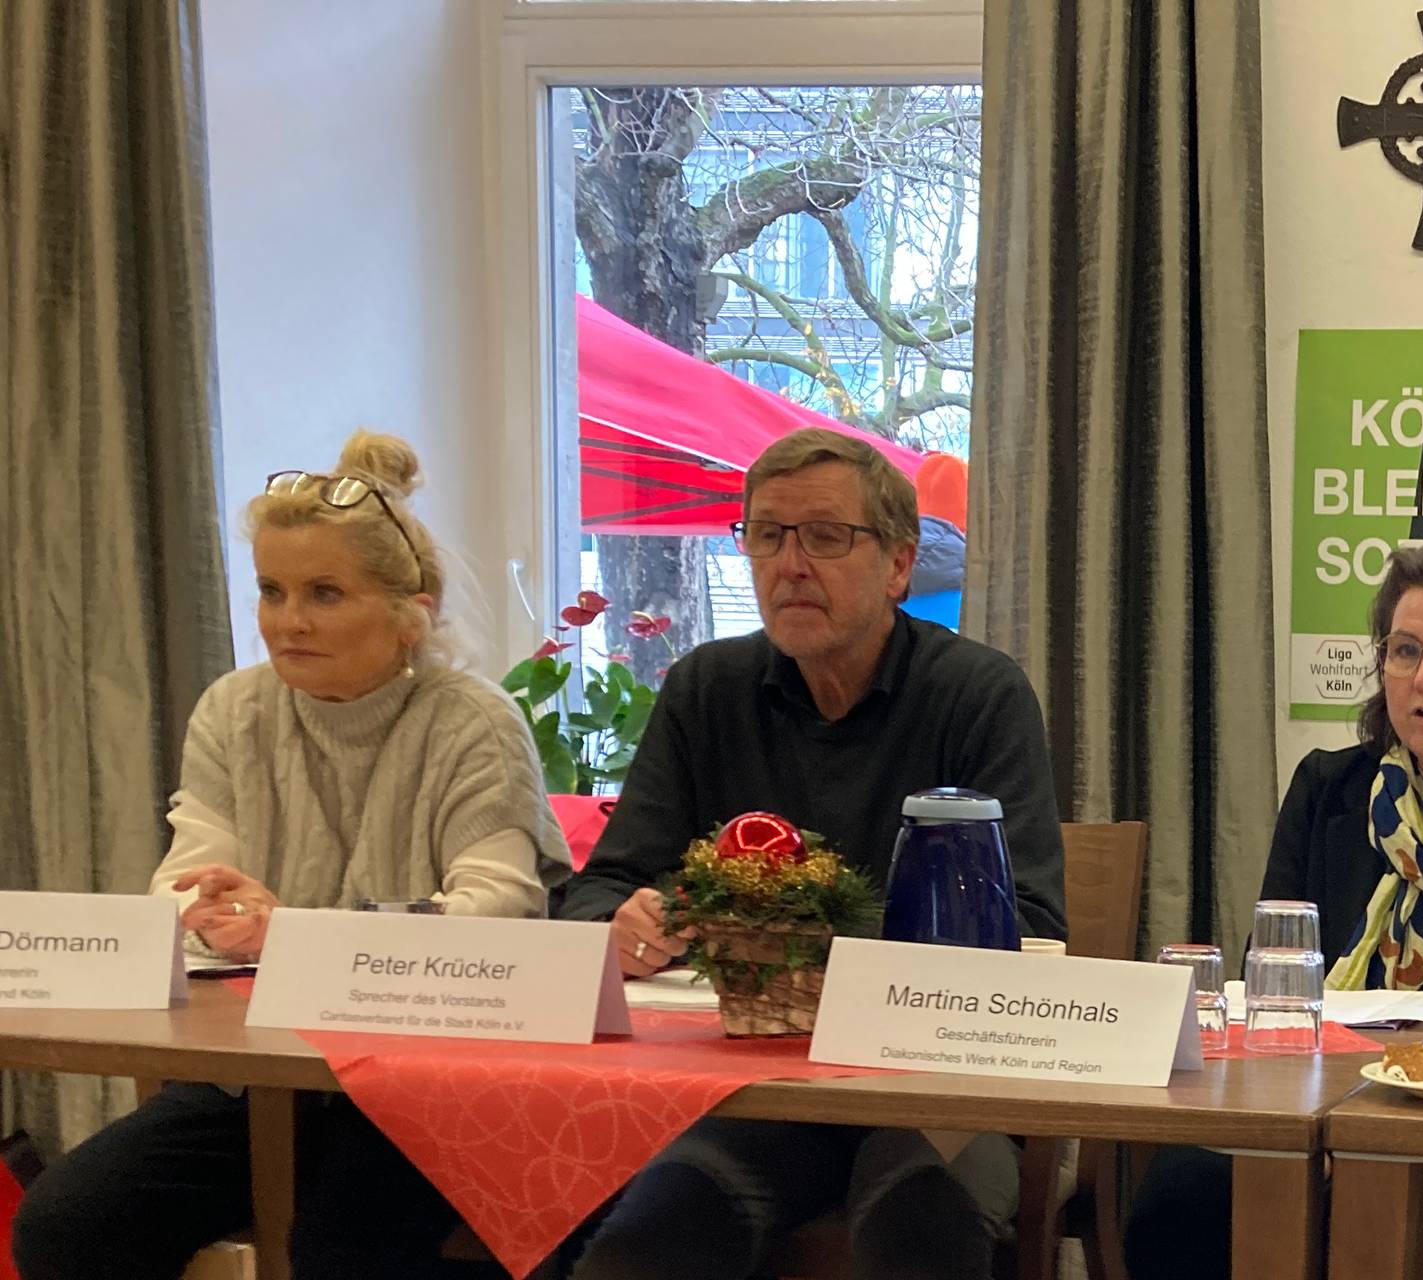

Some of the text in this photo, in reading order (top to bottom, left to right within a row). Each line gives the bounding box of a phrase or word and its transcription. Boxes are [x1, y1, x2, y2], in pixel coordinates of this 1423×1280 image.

[1328, 648, 1352, 661] Liga
[1310, 664, 1368, 675] Wohlfahrt
[1326, 679, 1352, 691] Köln
[352, 953, 515, 979] Peter Krücker
[348, 989, 506, 1008] Sprecher des Vorstands
[886, 984, 1119, 1023] Martina Schönhals
[936, 1026, 1057, 1048] Geschäftsführerin
[881, 1046, 1102, 1075] Diakonisches Werk Köln und Region
